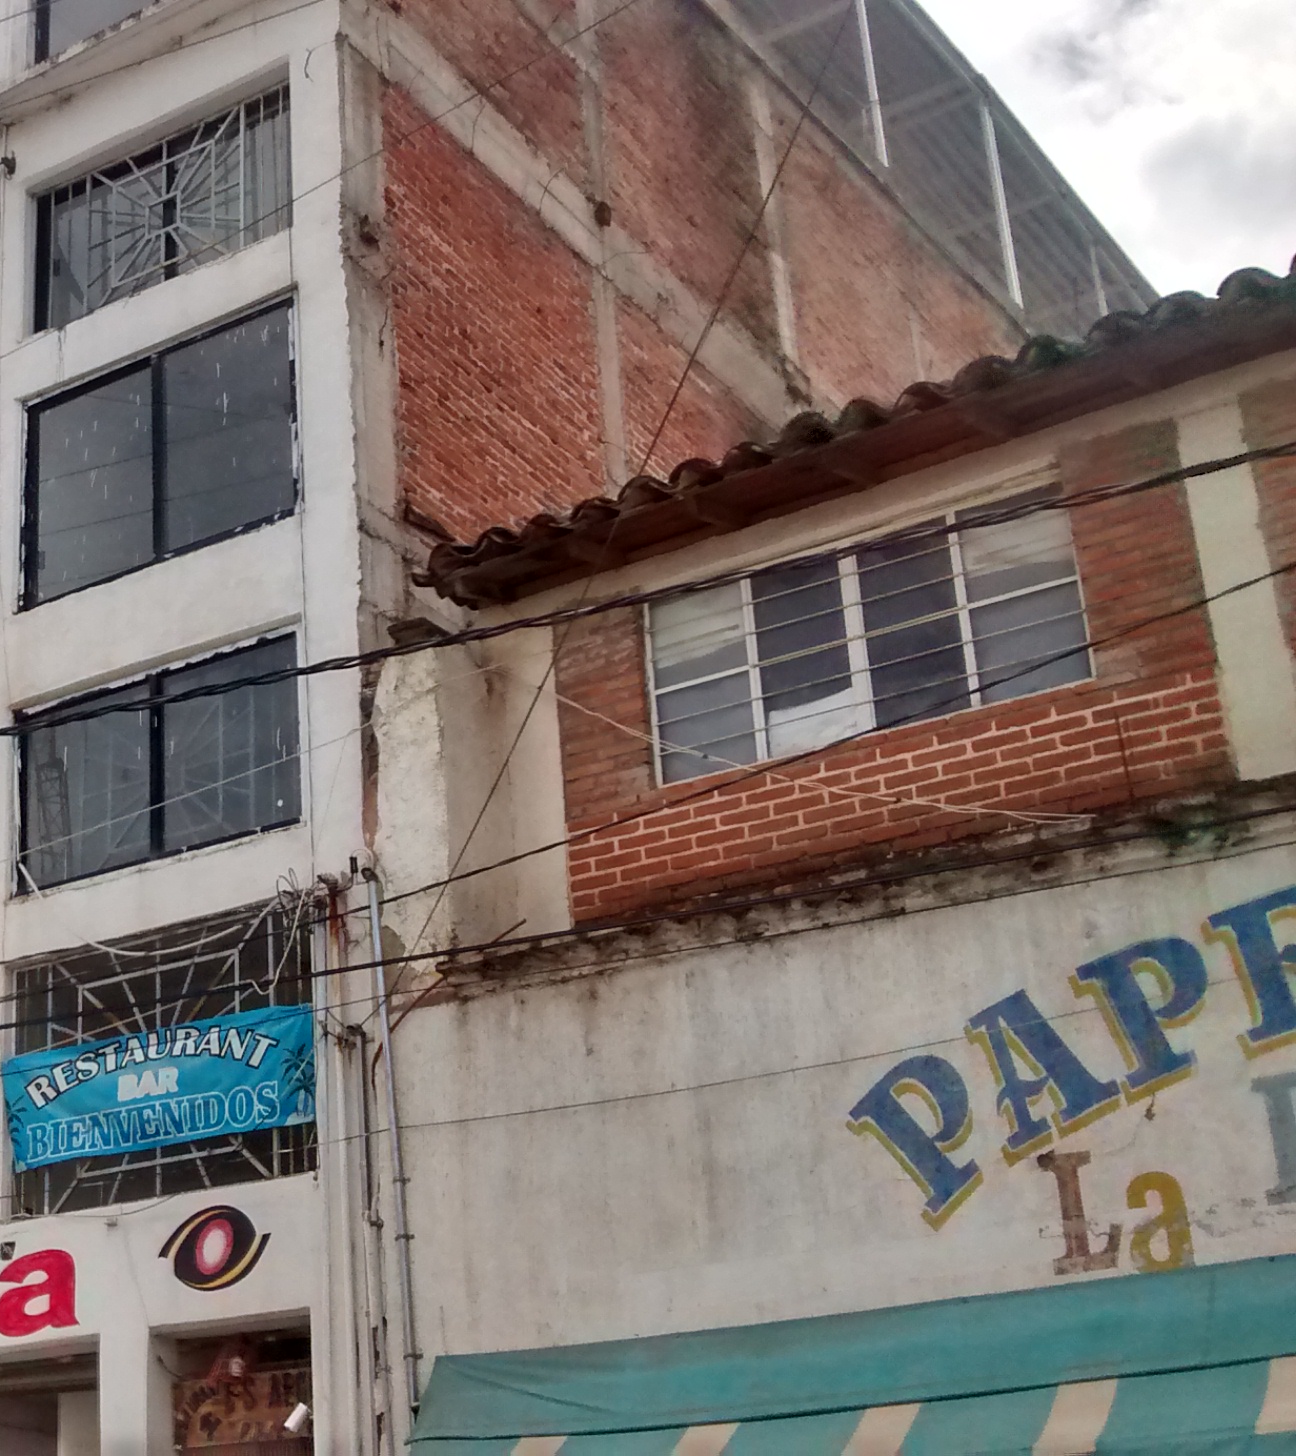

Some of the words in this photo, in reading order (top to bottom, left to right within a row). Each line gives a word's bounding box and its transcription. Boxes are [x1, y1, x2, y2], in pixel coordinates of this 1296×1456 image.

[24, 1025, 279, 1110] RESTAURANT
[117, 1066, 179, 1102] BAR
[26, 1080, 281, 1163] BIENVENIDOS
[1037, 1151, 1196, 1275] La
